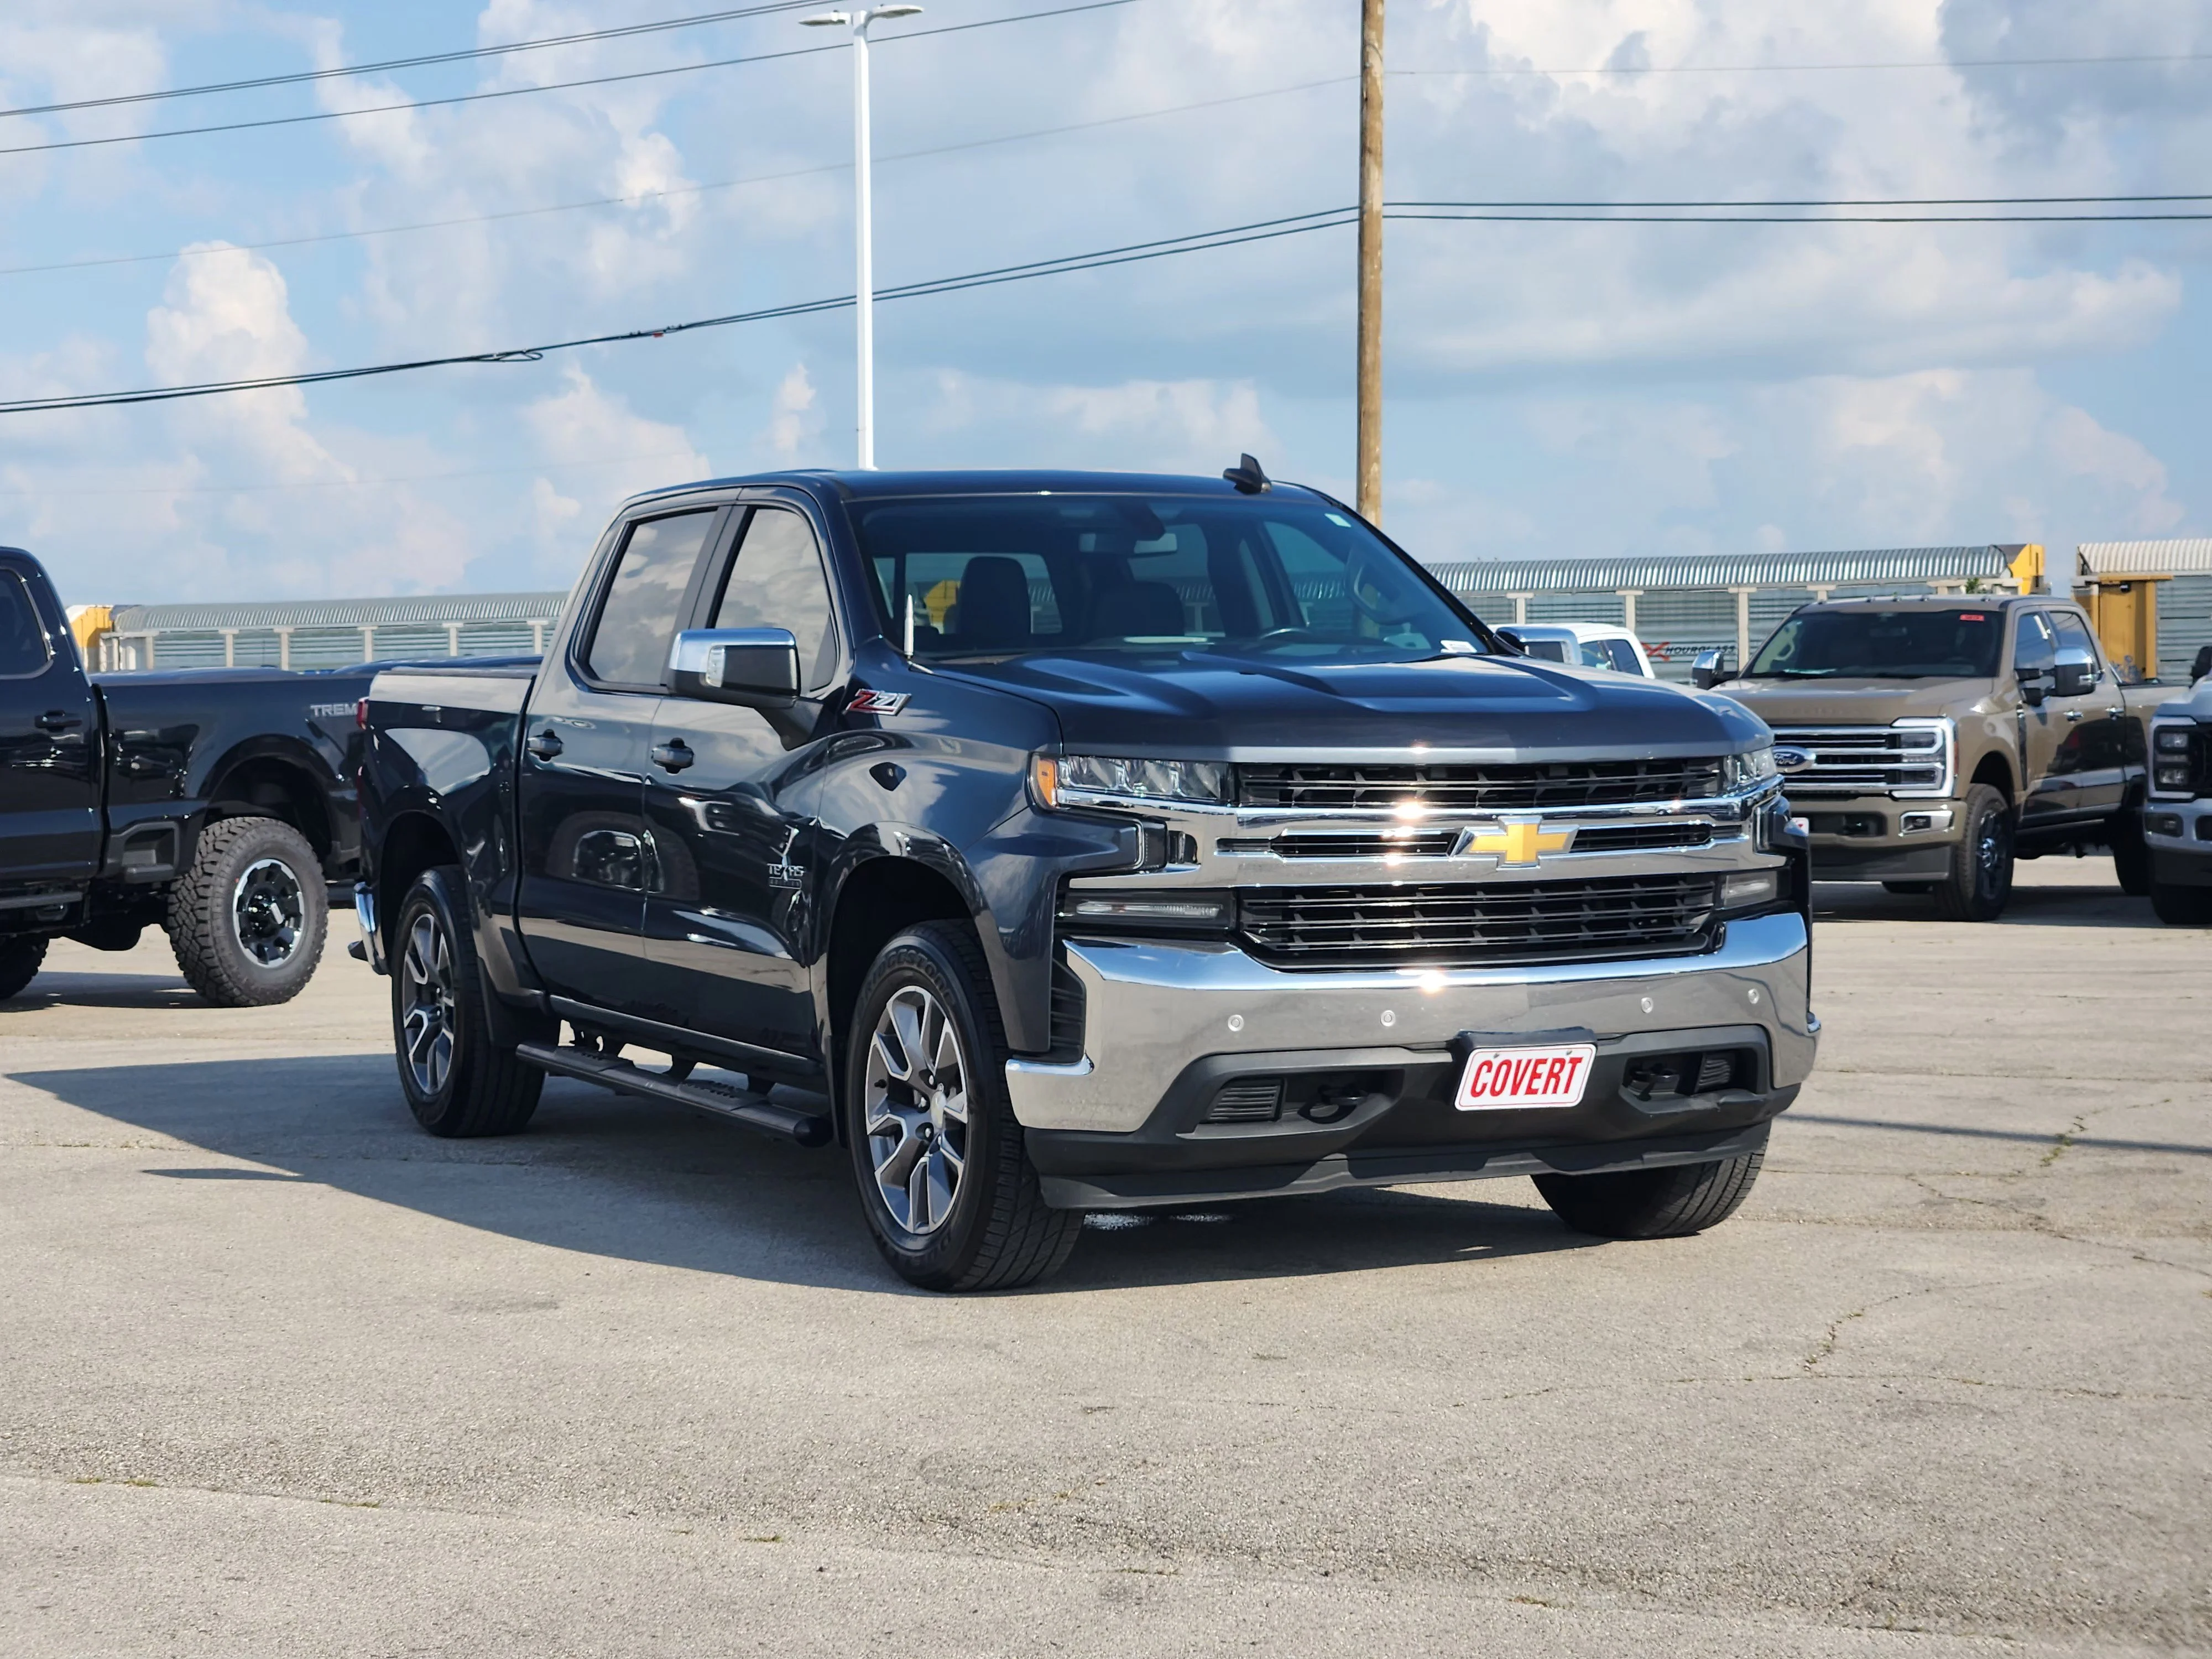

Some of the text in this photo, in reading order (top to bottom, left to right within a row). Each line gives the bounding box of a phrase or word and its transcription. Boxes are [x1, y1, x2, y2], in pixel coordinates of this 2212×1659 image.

[845, 688, 912, 716] Z71
[1773, 752, 1797, 765] Ford
[766, 863, 805, 880] TEXAS
[1470, 1057, 1583, 1098] COVERT
